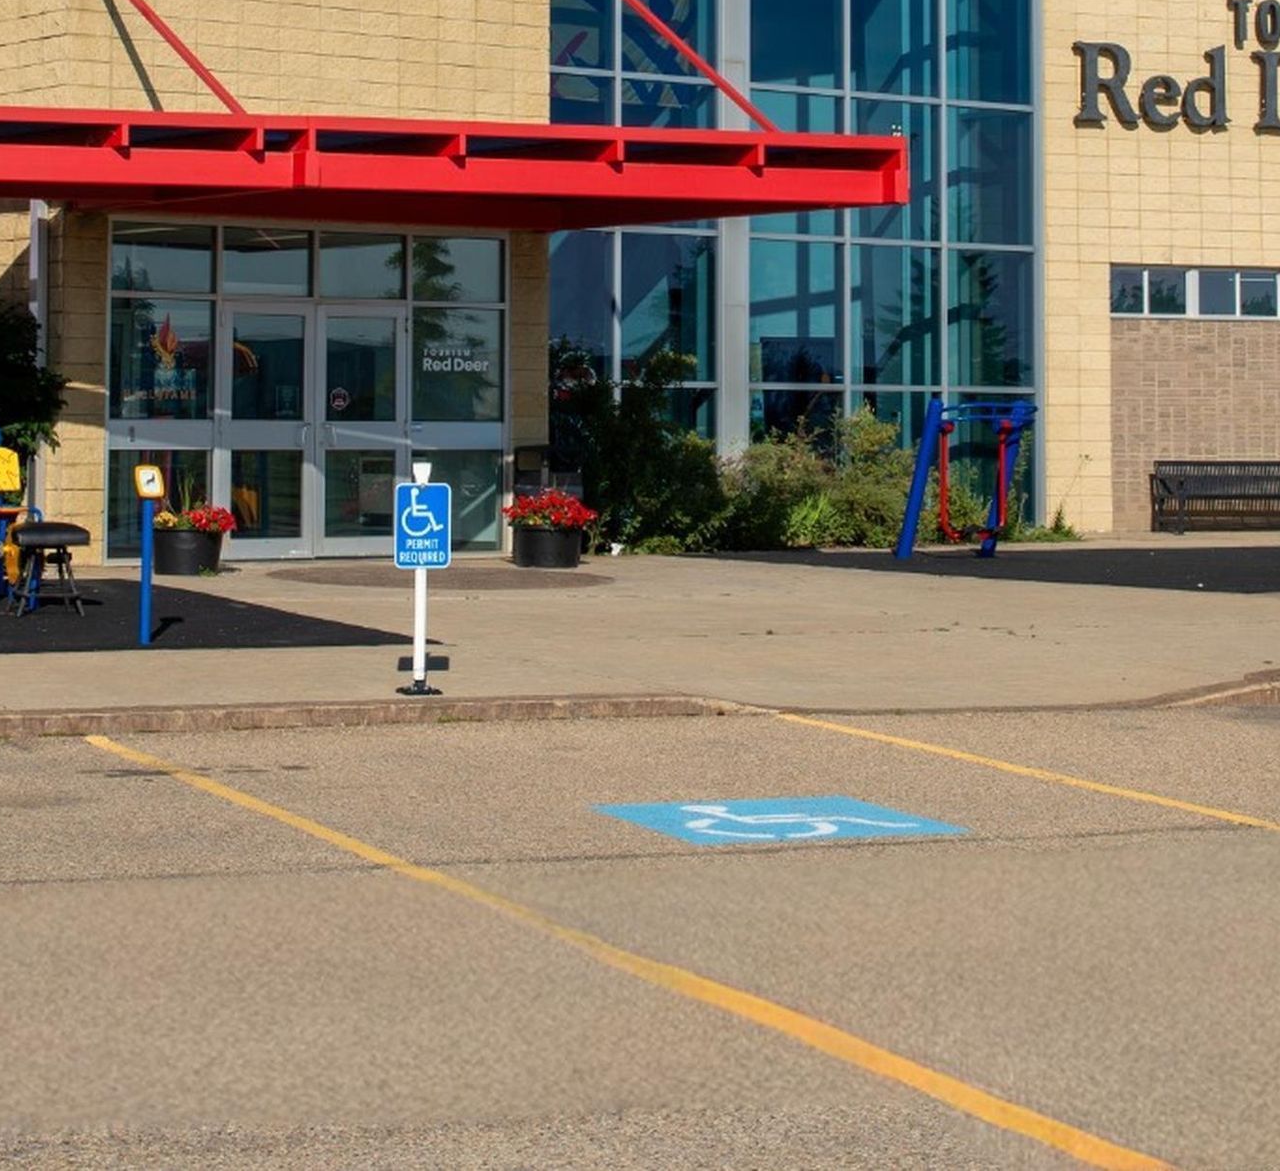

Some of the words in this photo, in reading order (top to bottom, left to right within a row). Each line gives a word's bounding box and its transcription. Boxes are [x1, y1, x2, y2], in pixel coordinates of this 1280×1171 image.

[1072, 40, 1232, 133] Red
[422, 357, 452, 372] Red
[453, 357, 489, 372] Deer
[405, 538, 439, 549] PERMIT
[399, 550, 446, 565] REQUIRED
